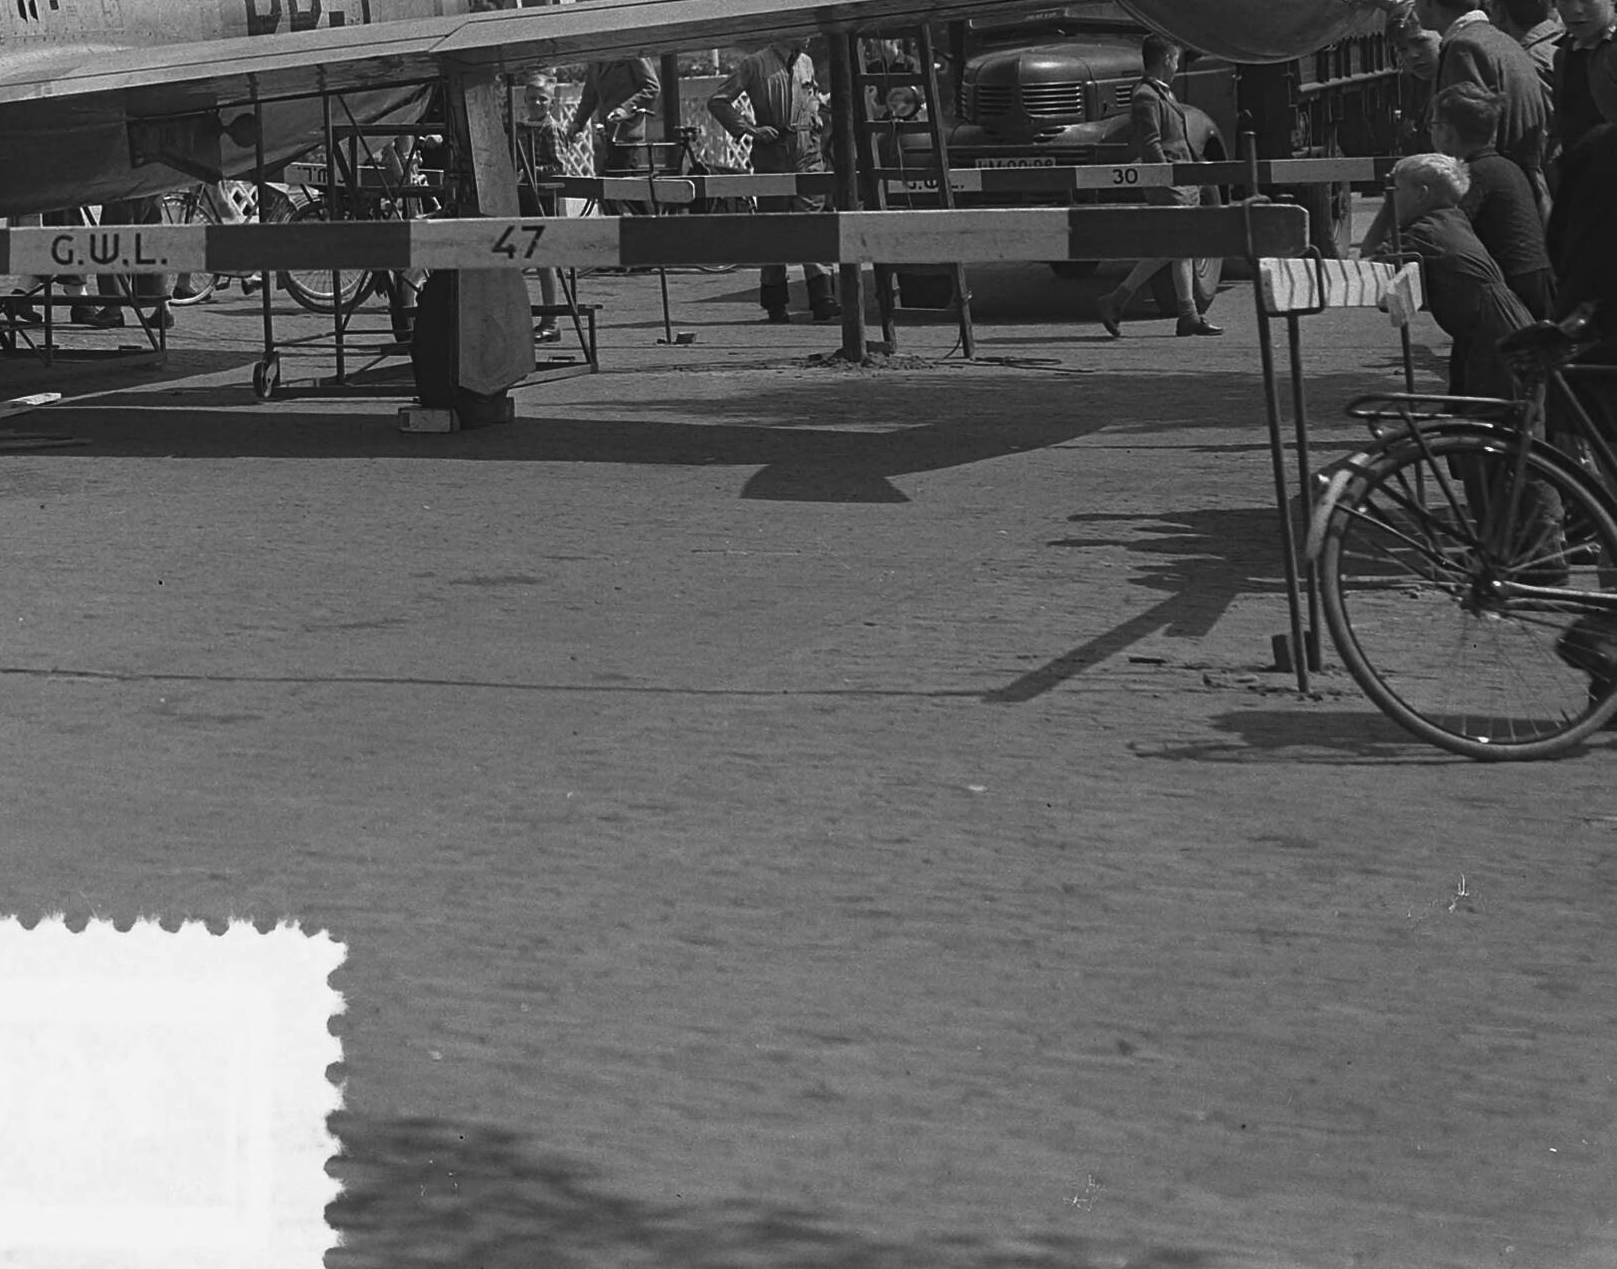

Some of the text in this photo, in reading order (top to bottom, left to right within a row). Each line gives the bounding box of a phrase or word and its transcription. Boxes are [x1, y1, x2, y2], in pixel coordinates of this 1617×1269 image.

[1112, 168, 1138, 184] 30
[51, 232, 168, 266] G.W.L.
[491, 225, 546, 259] 47
